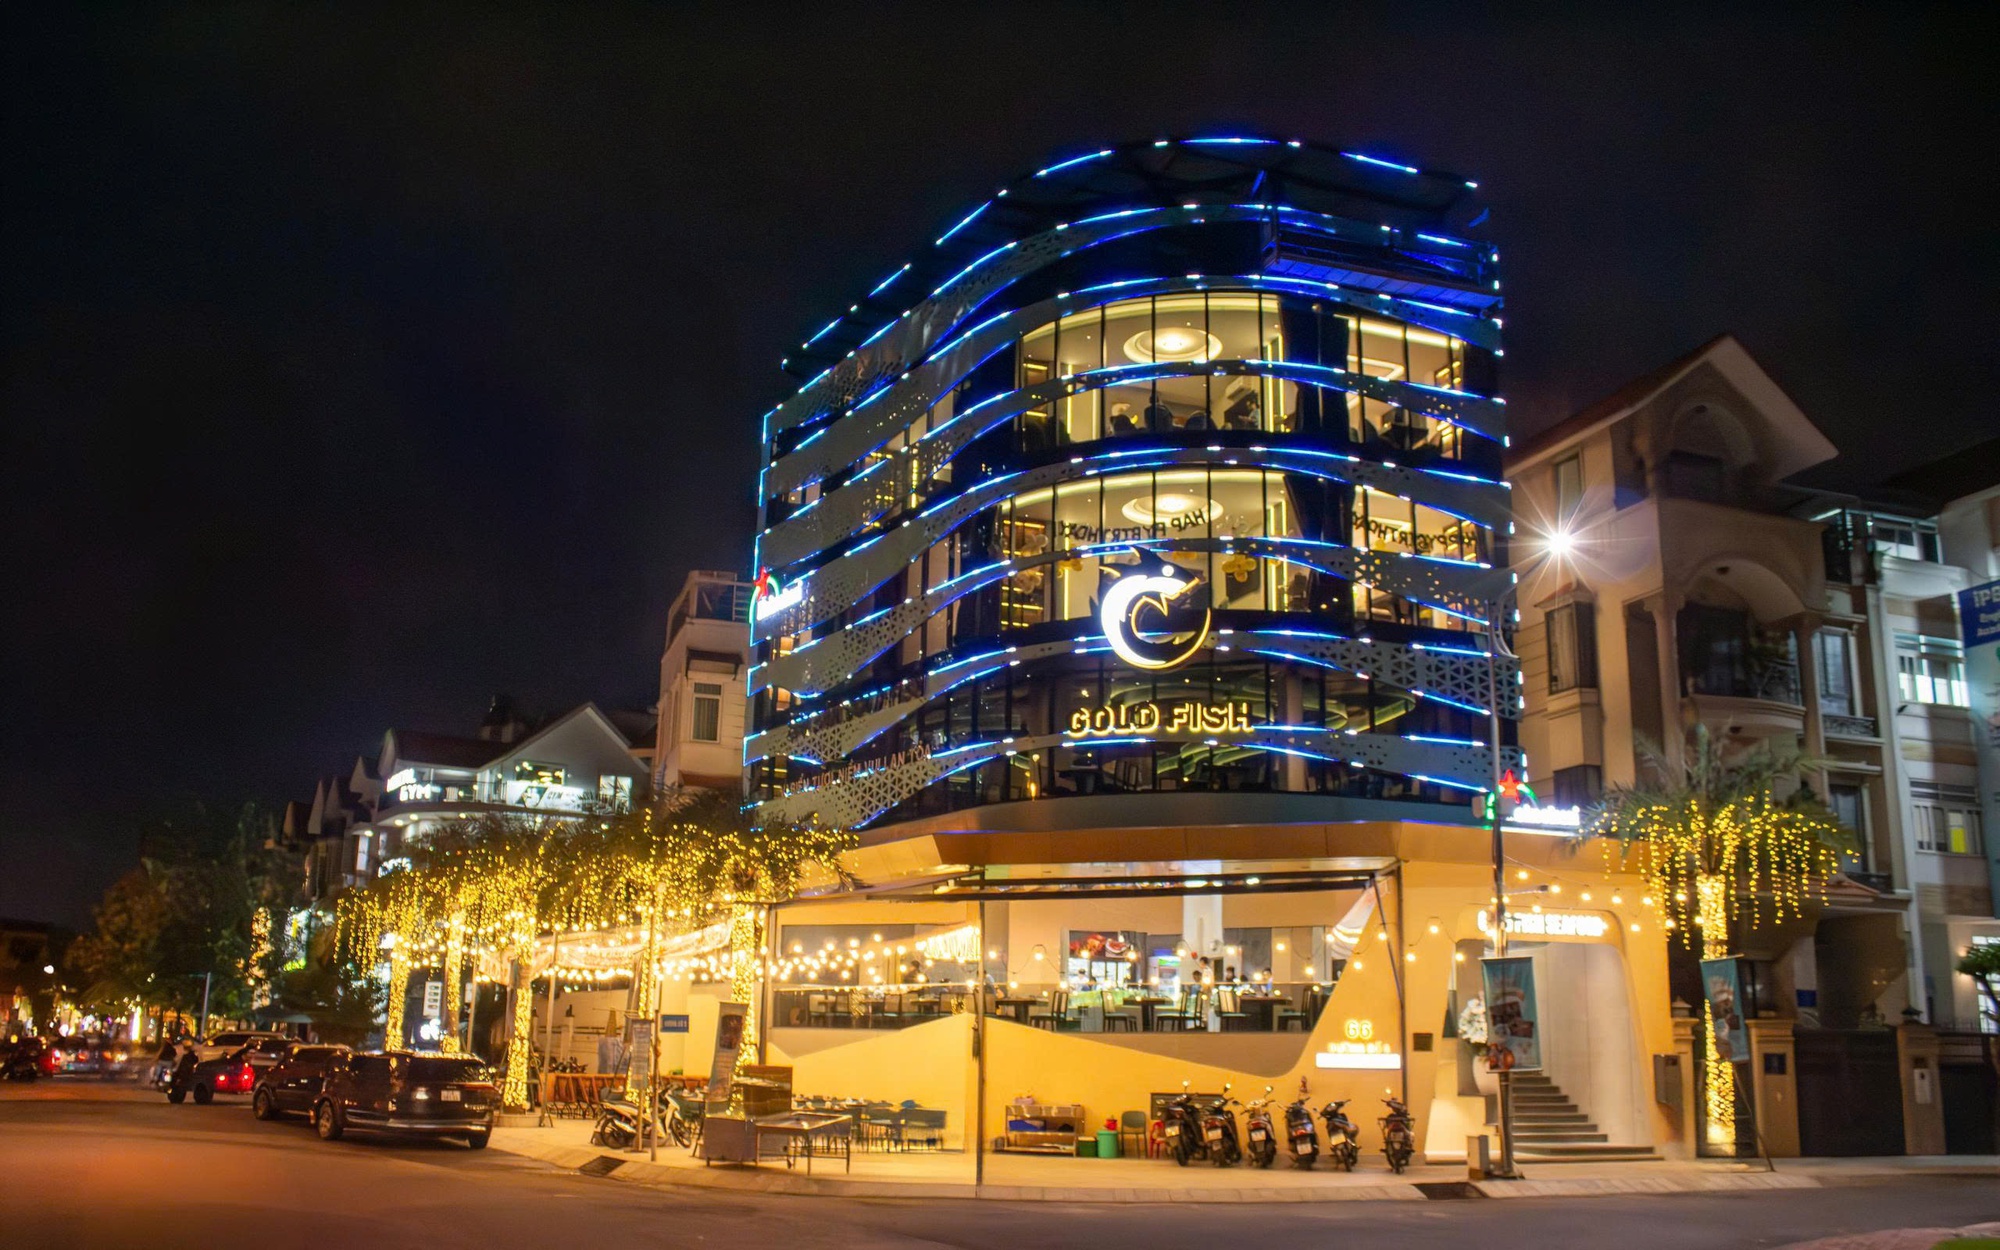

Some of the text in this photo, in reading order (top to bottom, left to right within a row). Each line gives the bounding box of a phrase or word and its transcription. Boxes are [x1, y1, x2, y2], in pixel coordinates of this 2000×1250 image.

[1067, 701, 1255, 738] GOLD FISH
[1344, 1019, 1374, 1040] 66
